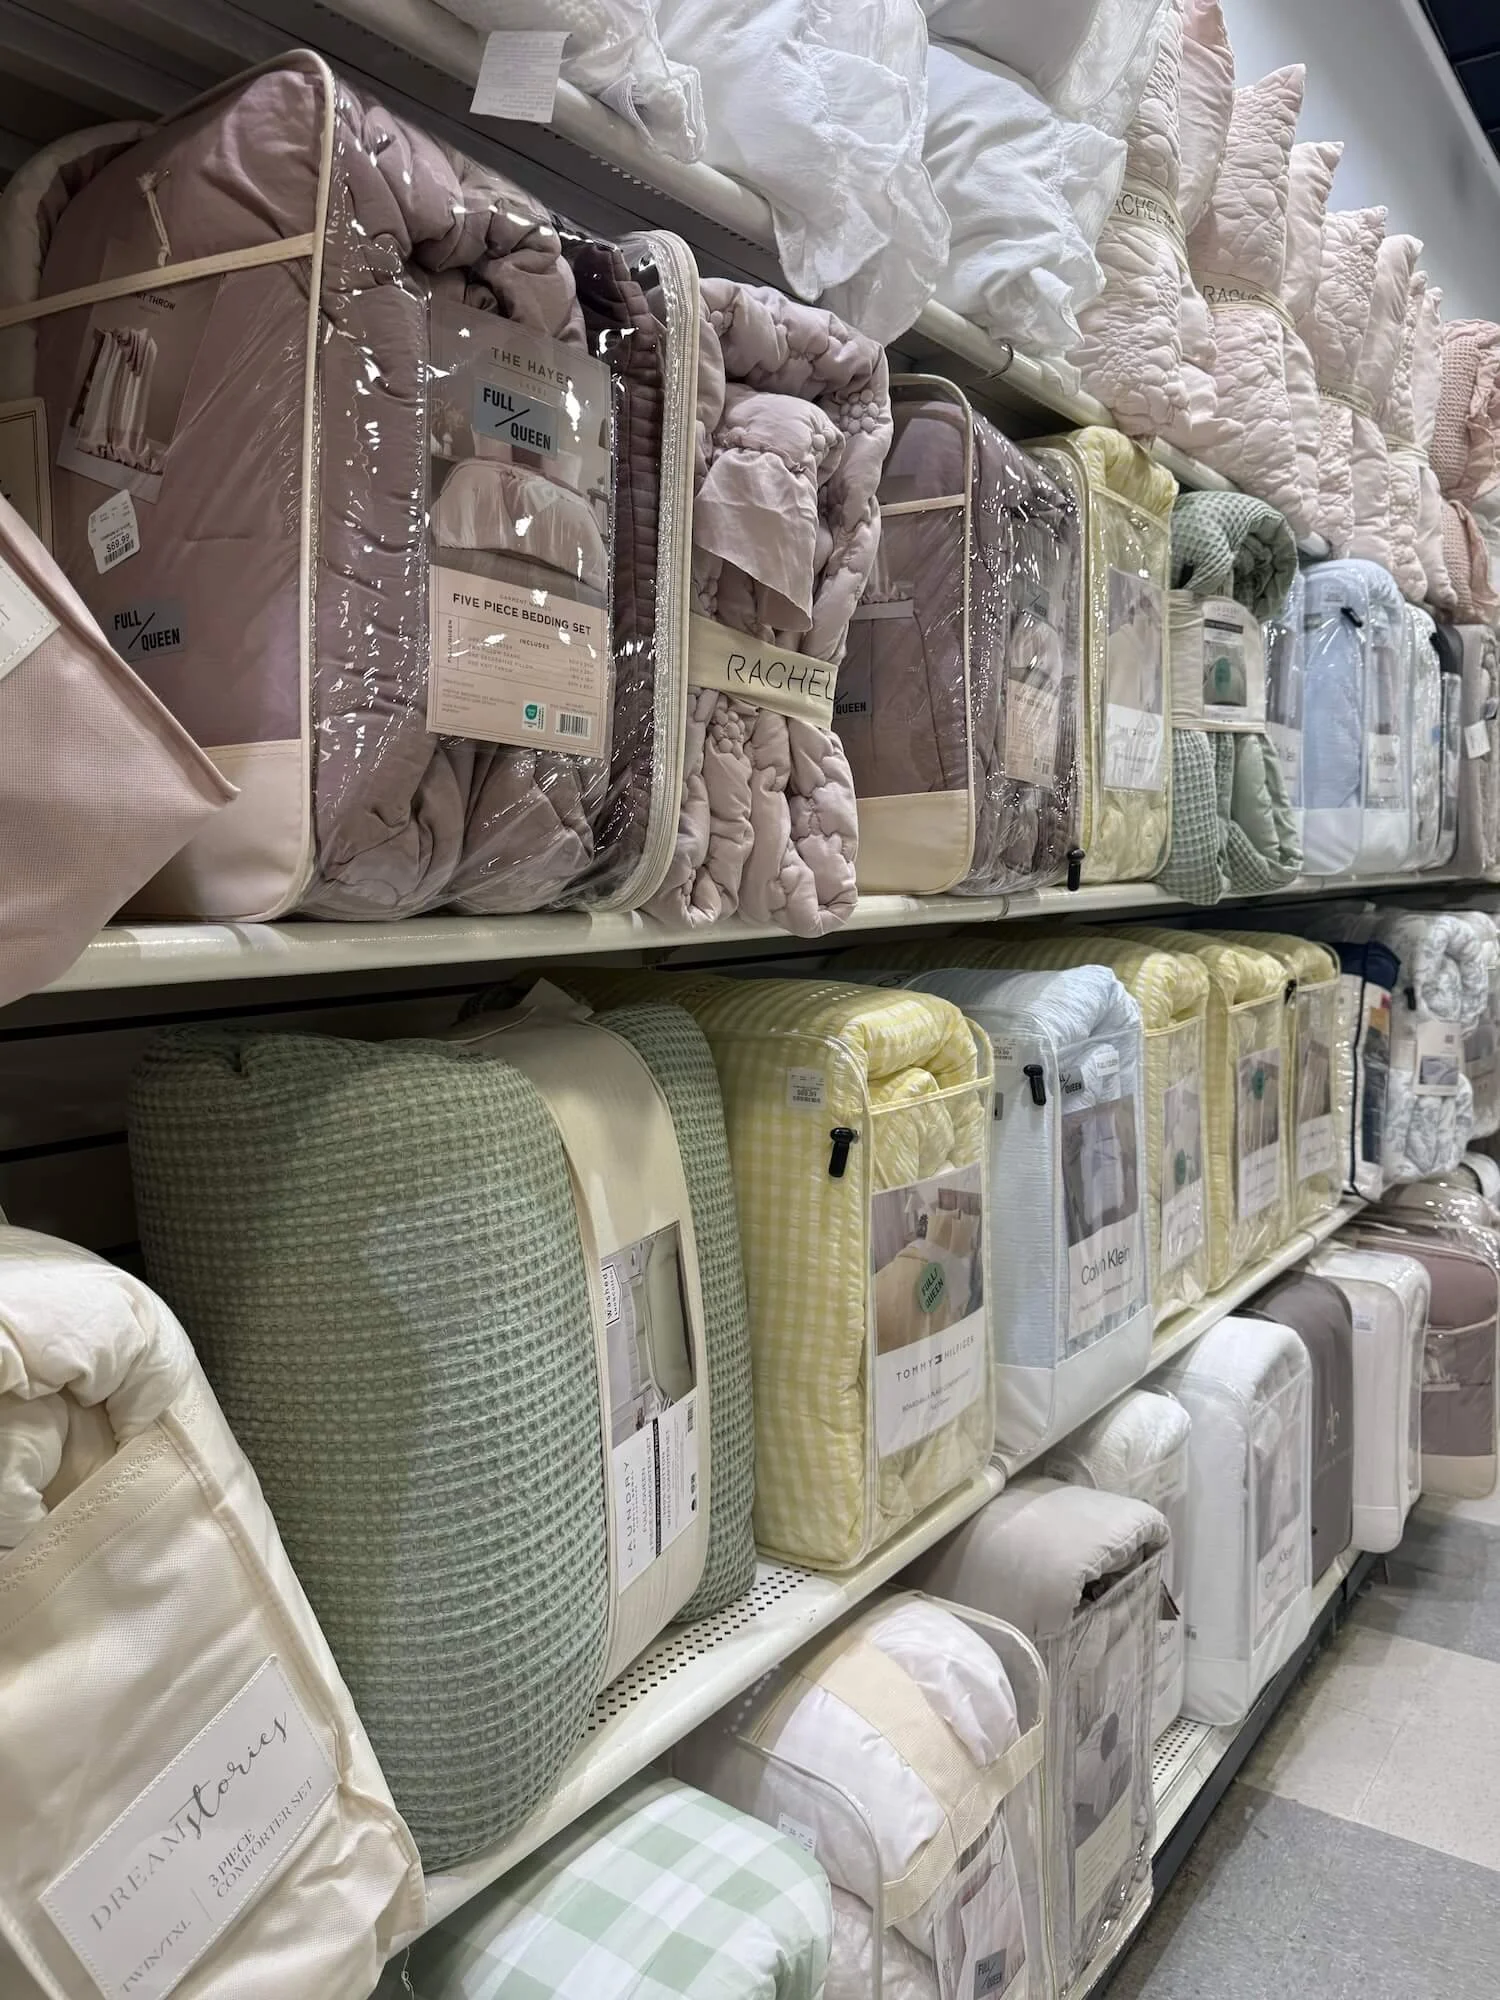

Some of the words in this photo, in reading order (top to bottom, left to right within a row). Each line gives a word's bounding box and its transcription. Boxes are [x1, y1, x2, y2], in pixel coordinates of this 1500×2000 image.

[1115, 194, 1162, 223] ACHEL
[149, 295, 176, 311] THROW
[491, 347, 521, 368] THE
[483, 387, 515, 413] FULL
[510, 422, 551, 451] QUEEN
[114, 610, 142, 631] FULL
[453, 592, 480, 608] FIVE
[484, 600, 519, 618] PIECE
[522, 610, 569, 629] BEDDING
[572, 622, 592, 636] SET
[141, 628, 180, 652] QUEEN
[519, 639, 550, 650] INCLUDES
[836, 701, 866, 715] QUEEN
[896, 1358, 934, 1382] TOMMY
[944, 1335, 976, 1360] HILFIGER
[624, 1461, 634, 1569] LAUNDRY
[217, 1806, 292, 1898] COMFORTER
[290, 1776, 313, 1808] SET
[208, 1874, 219, 1888] 3
[218, 1829, 255, 1876] PIECE
[120, 1918, 192, 1994] TWIN/TXL
